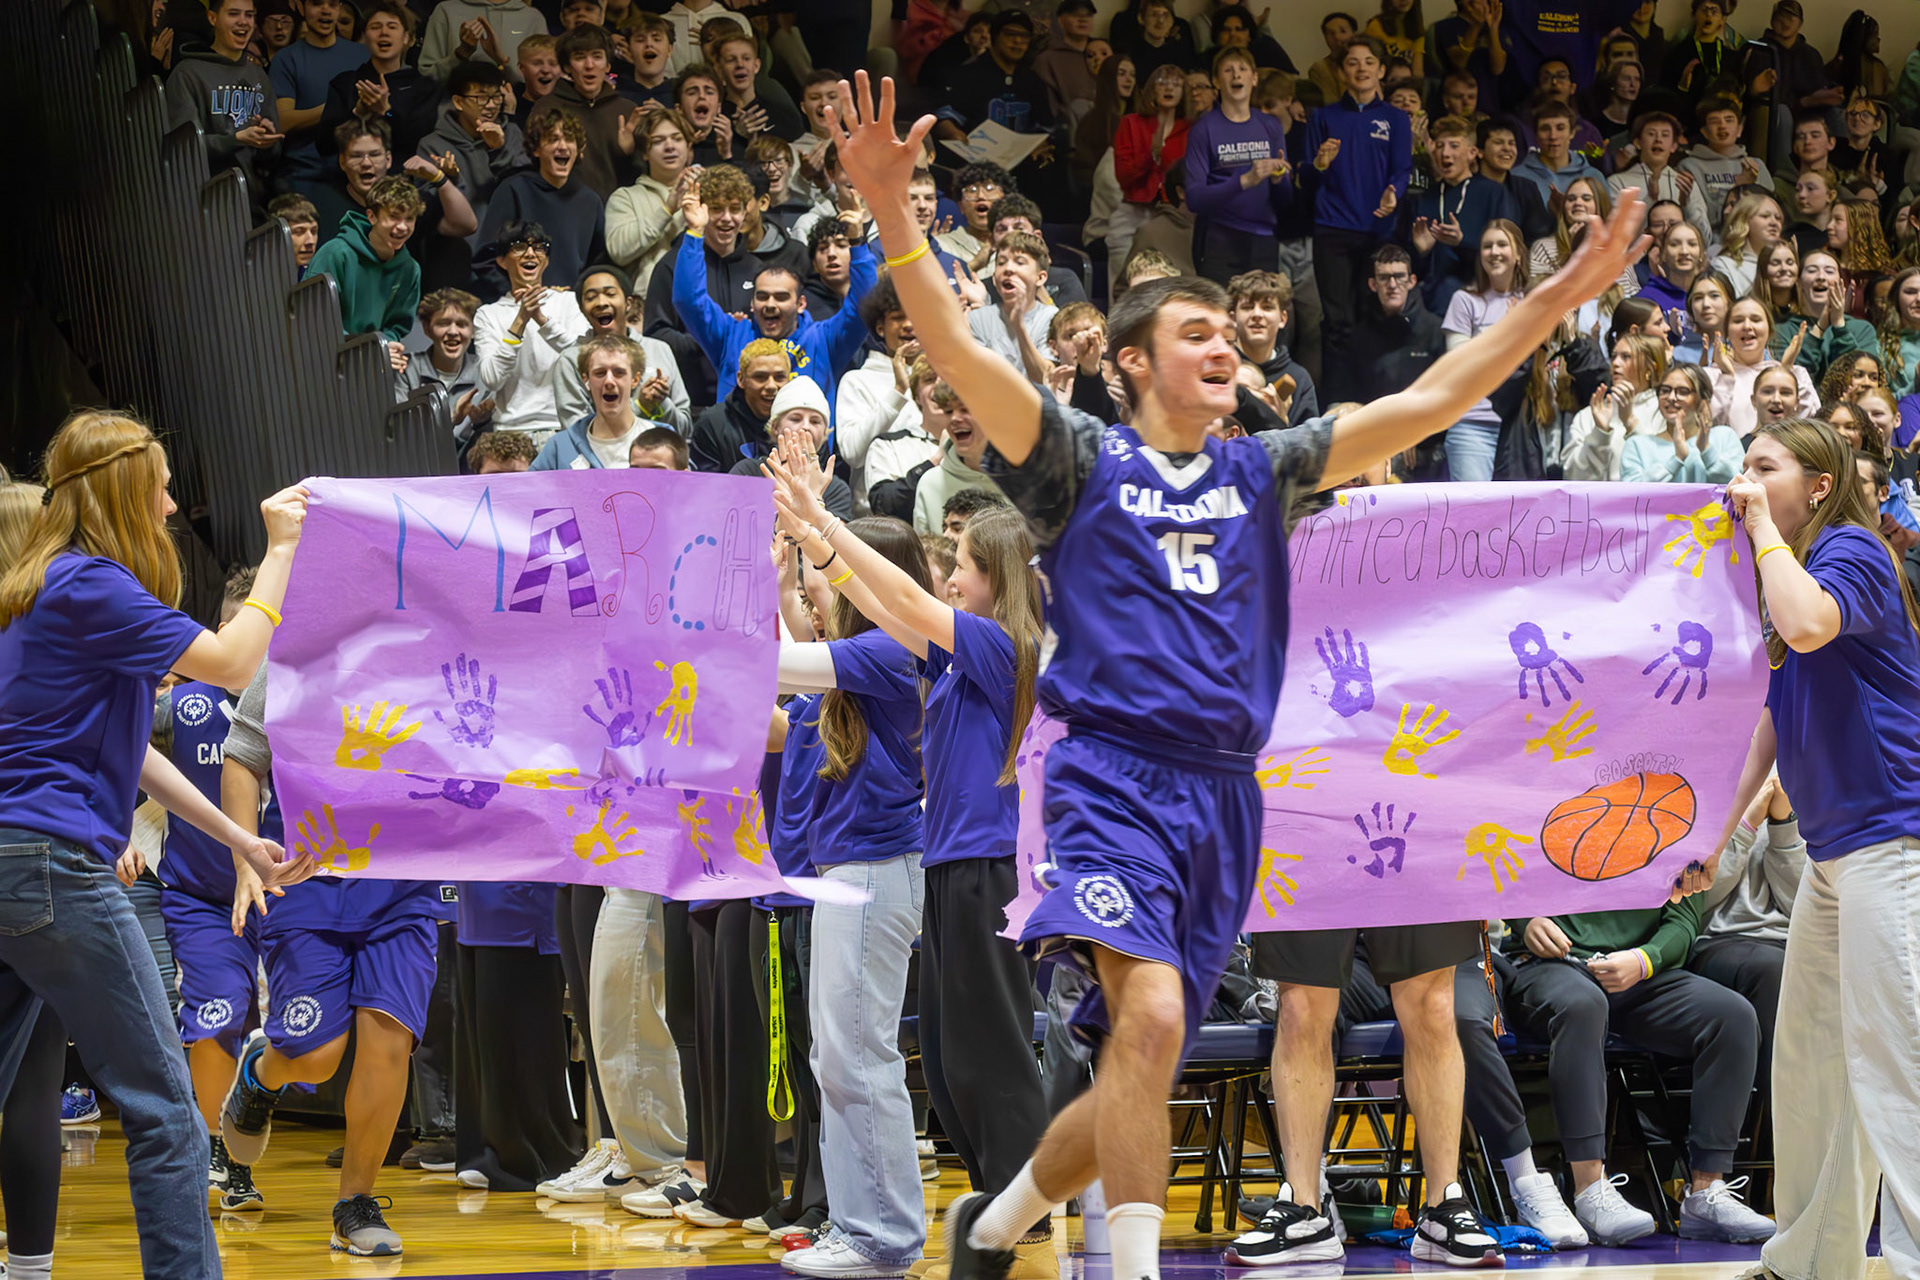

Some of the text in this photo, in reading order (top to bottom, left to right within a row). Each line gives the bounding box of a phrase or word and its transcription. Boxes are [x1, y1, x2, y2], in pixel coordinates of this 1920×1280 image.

[1217, 140, 1270, 155] CALEDONIA
[393, 486, 760, 638] MARCH
[1156, 531, 1220, 595] 15
[1289, 492, 1652, 588] nified basketball
[1594, 759, 1622, 787] GO
